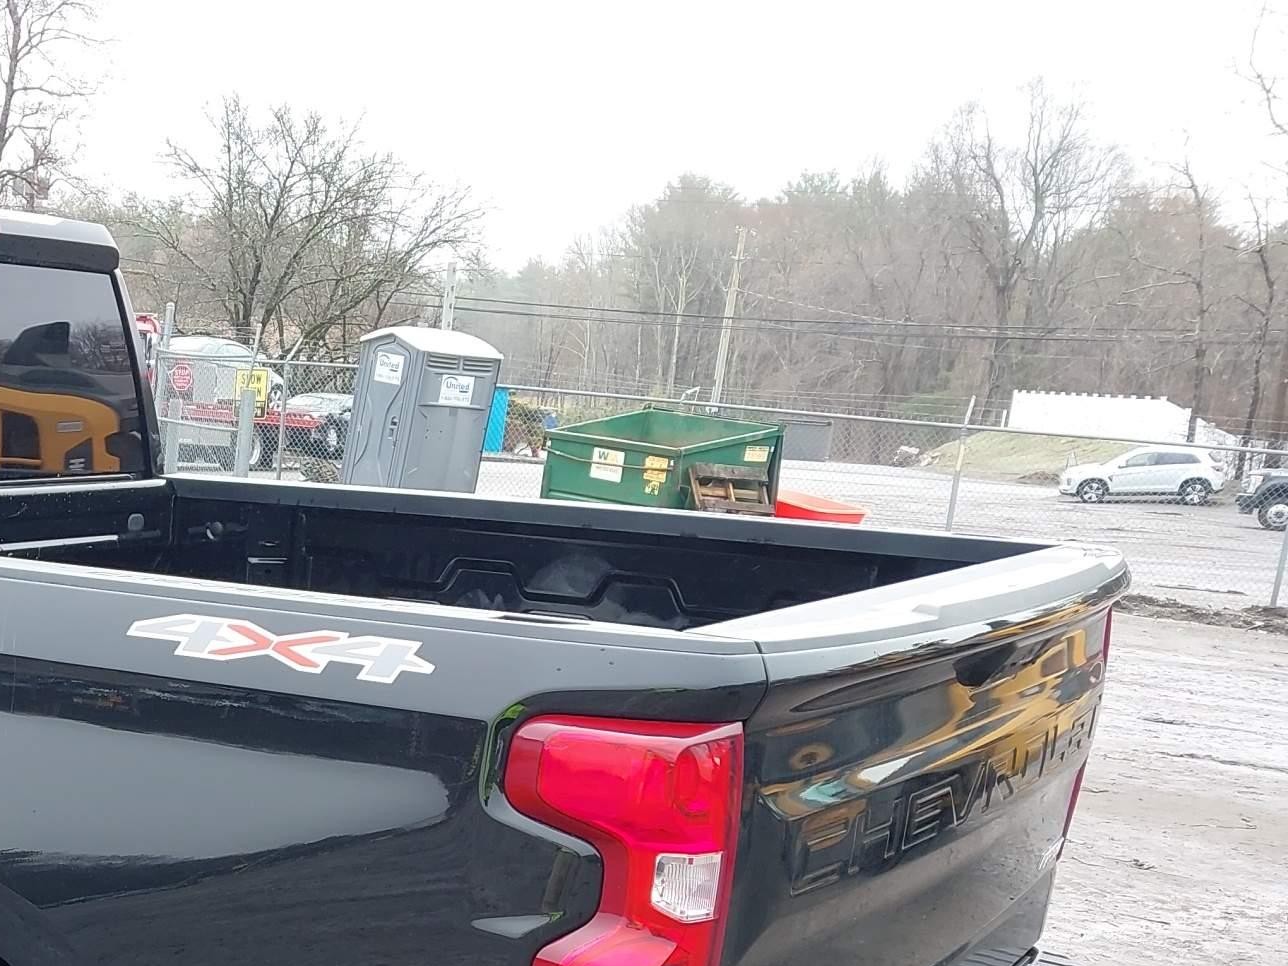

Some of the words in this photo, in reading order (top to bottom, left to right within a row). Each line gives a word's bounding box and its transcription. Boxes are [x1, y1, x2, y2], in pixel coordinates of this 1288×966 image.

[379, 359, 400, 370] United
[446, 381, 470, 391] United
[790, 695, 1103, 897] CHEVROLET
